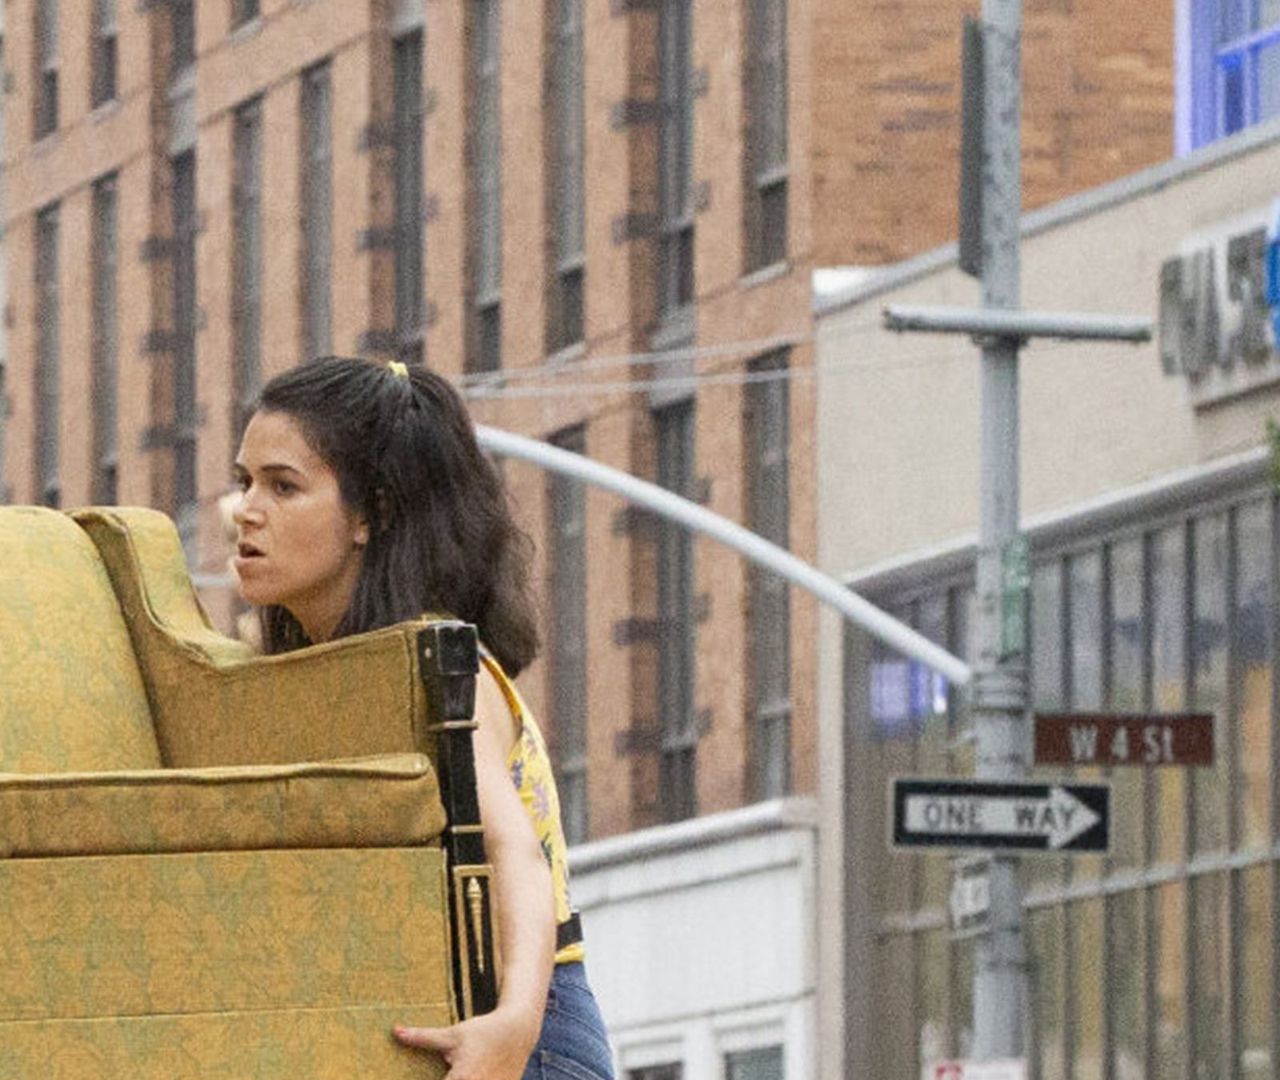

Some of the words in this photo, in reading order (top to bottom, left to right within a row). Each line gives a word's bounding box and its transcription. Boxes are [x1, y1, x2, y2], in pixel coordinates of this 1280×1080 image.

[1069, 724, 1098, 762] W
[1110, 725, 1129, 760] 4
[923, 800, 983, 831] ONE
[1014, 802, 1076, 831] WAY
